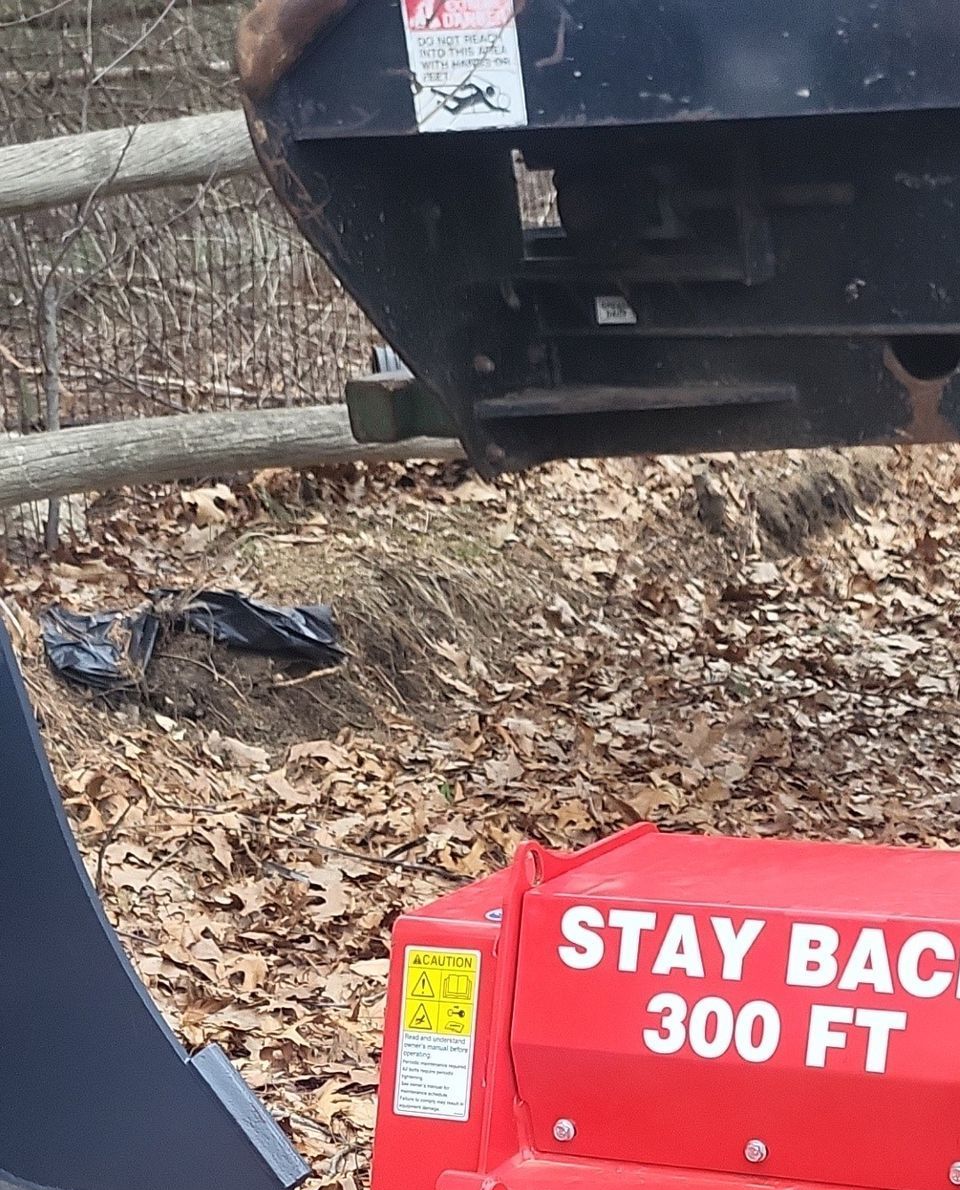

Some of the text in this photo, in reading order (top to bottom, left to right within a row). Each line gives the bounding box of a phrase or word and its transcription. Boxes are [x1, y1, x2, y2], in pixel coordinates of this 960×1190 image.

[418, 37, 434, 47] DO
[437, 36, 460, 46] NOT
[420, 48, 446, 58] INTO
[449, 47, 474, 57] THIS
[422, 60, 449, 71] WITH
[558, 905, 766, 981] STAY
[423, 954, 472, 968] CAUTION
[405, 1033, 419, 1041] Read
[643, 992, 908, 1074] 300 FT
